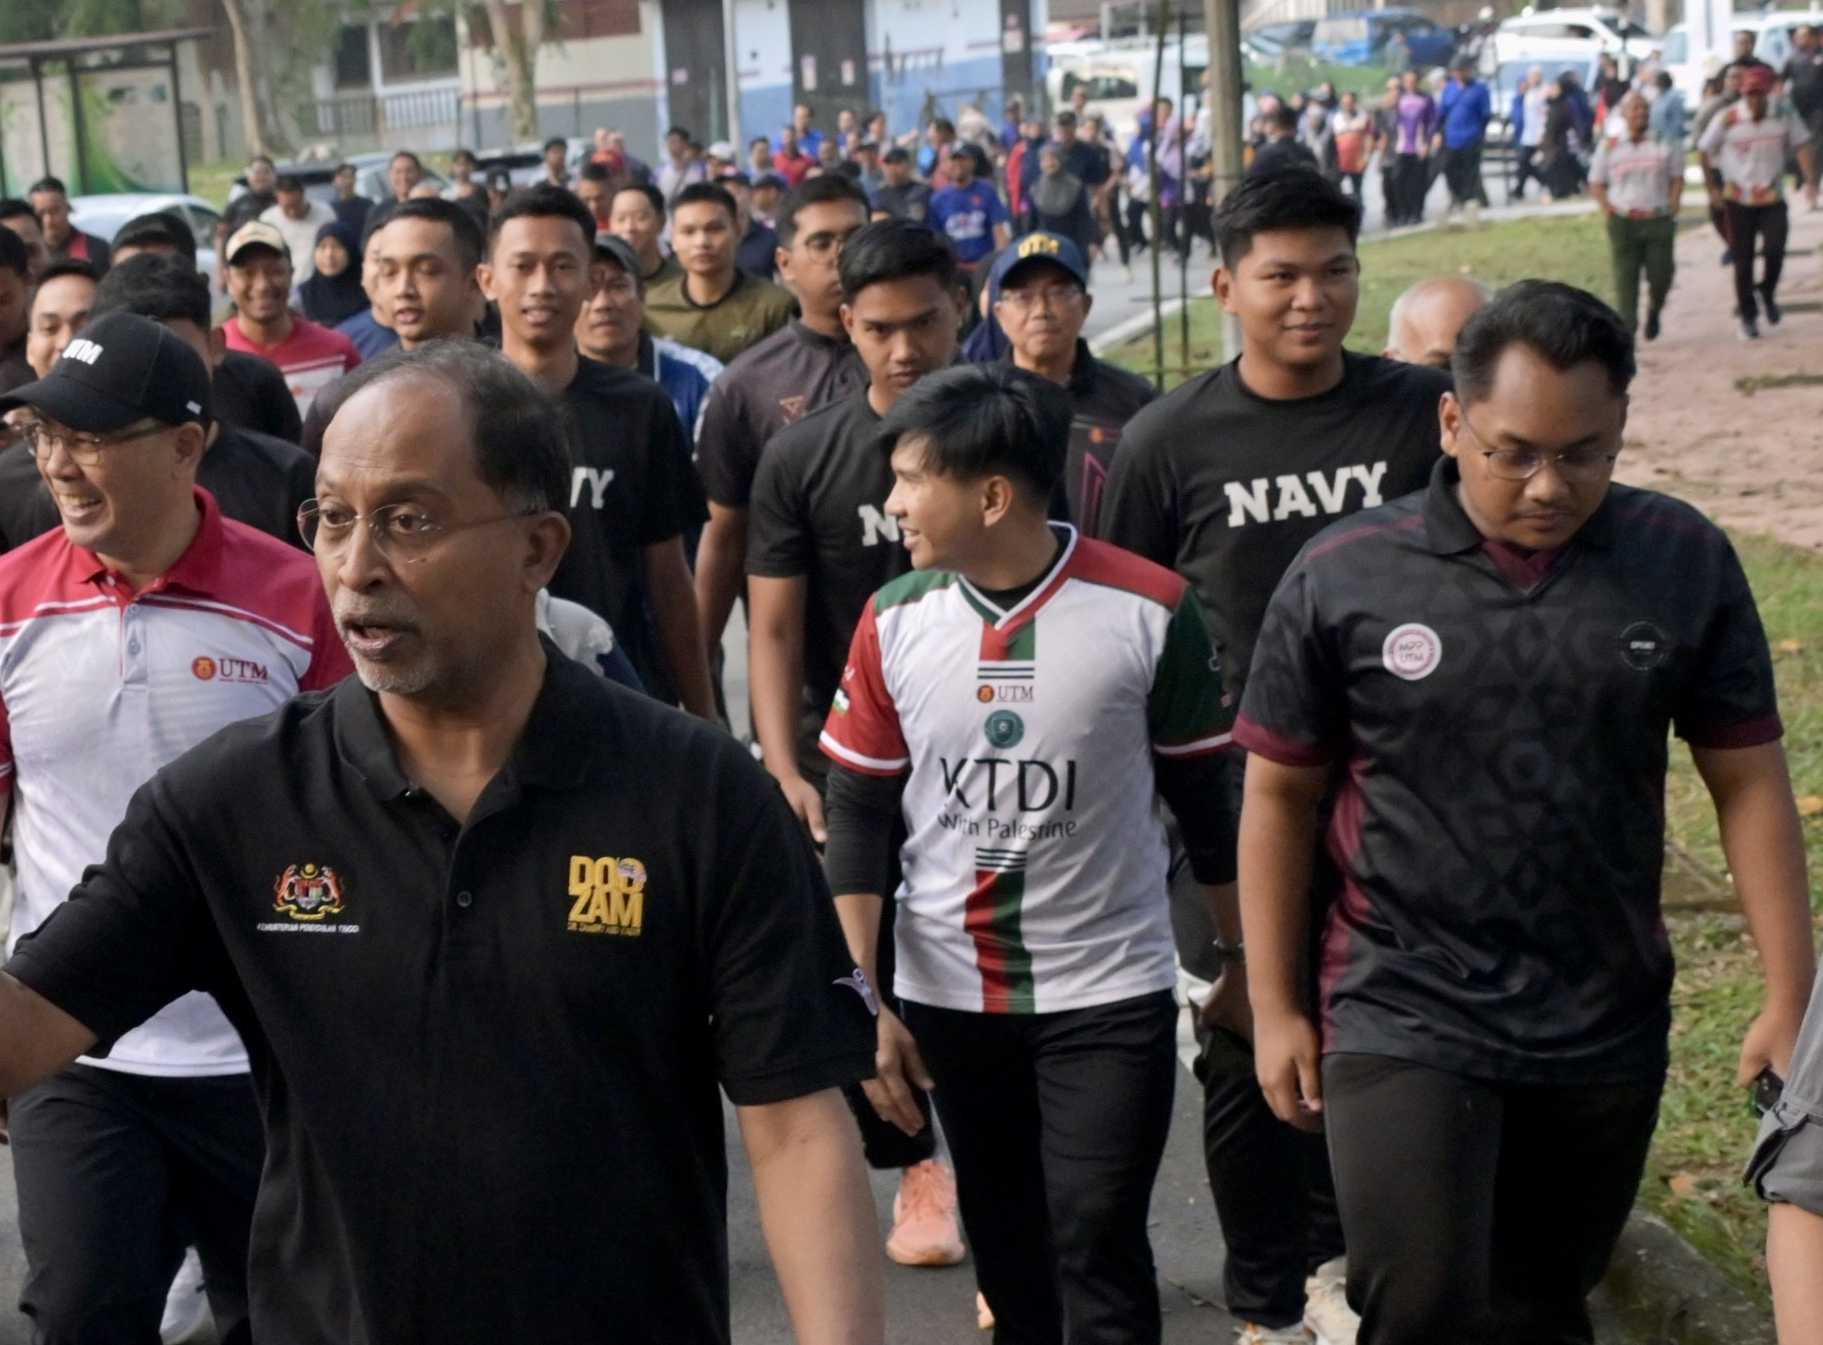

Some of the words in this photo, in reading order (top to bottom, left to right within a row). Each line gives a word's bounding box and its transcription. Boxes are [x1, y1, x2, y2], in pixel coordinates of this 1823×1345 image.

[1224, 461, 1387, 528] NAVY
[219, 658, 268, 680] UTM
[998, 686, 1034, 700] UTM
[940, 757, 1076, 812] KTDI
[568, 887, 643, 928] ZAM
